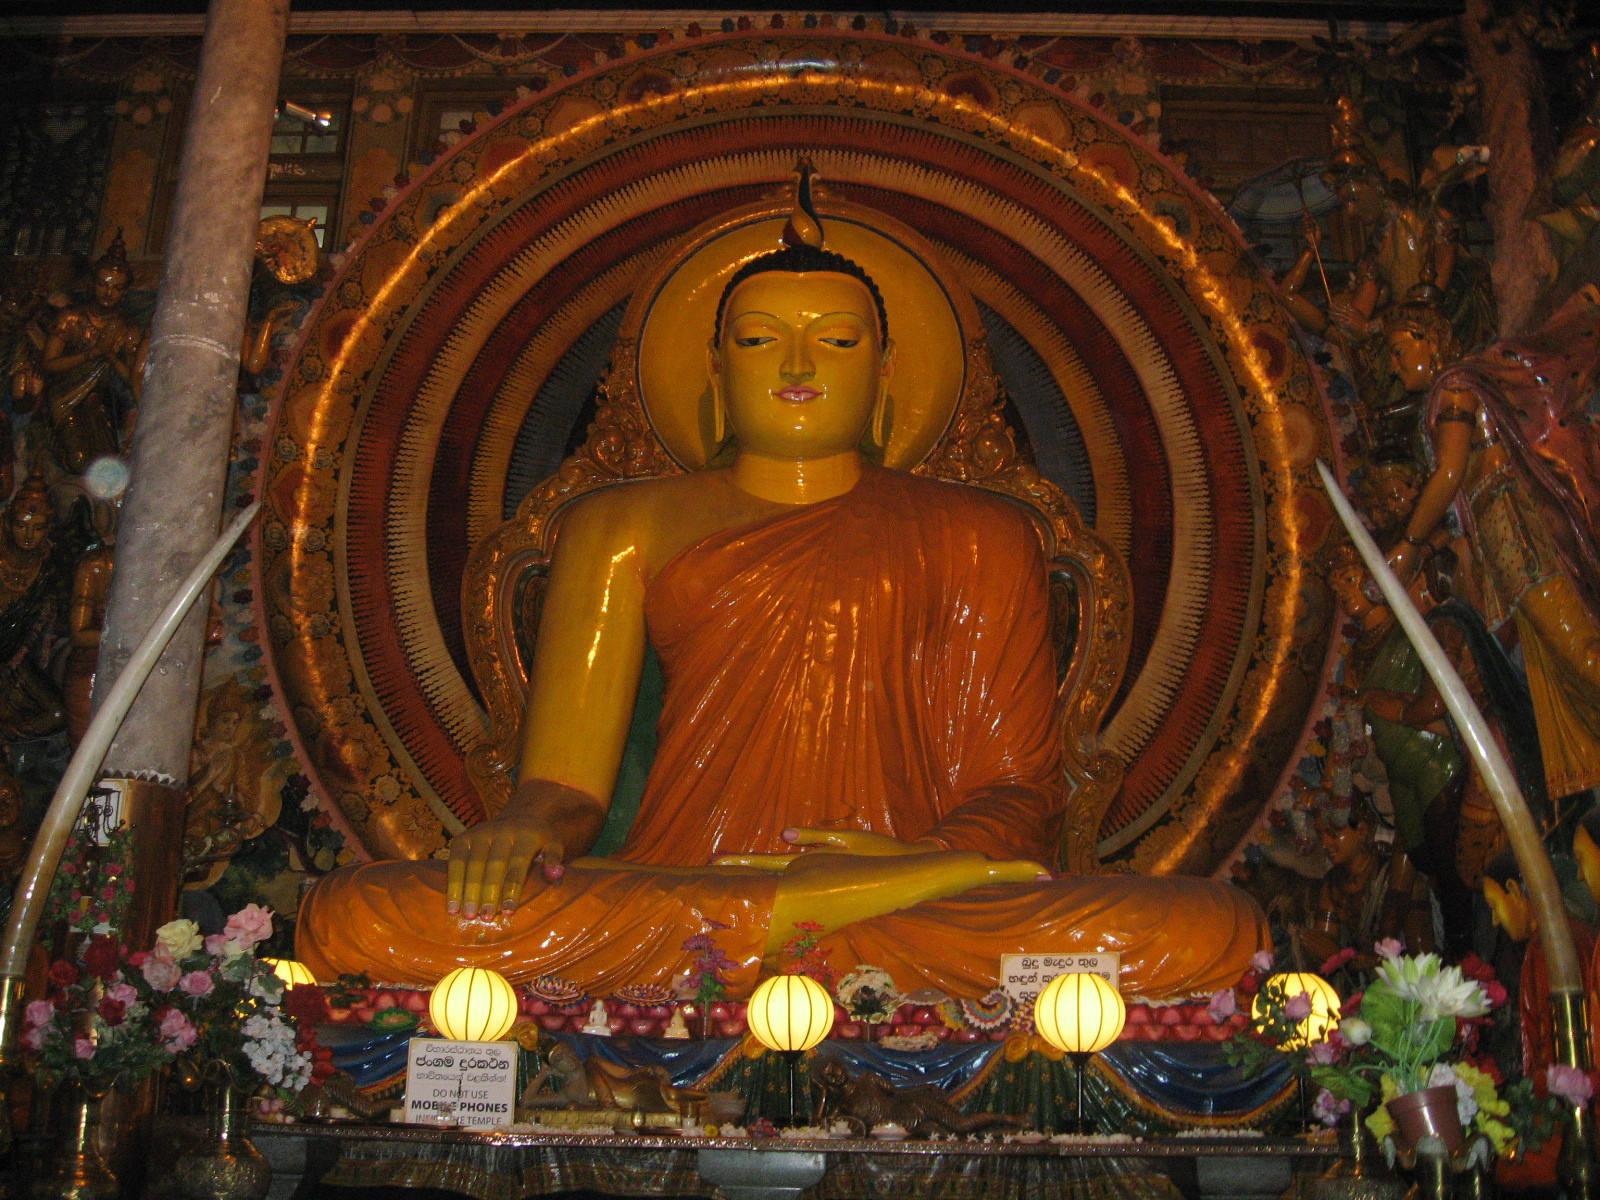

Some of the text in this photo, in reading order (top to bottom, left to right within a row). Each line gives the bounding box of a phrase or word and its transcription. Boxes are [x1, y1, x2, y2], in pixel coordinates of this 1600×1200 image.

[1021, 957, 1039, 969] බුදු
[1043, 956, 1074, 969] මැදුර
[416, 1055, 509, 1071] ජංගම දුරකථන
[433, 1088, 488, 1100] DO NOT USE
[460, 1102, 508, 1113] PHONES
[467, 1116, 502, 1126] TEMPLE
